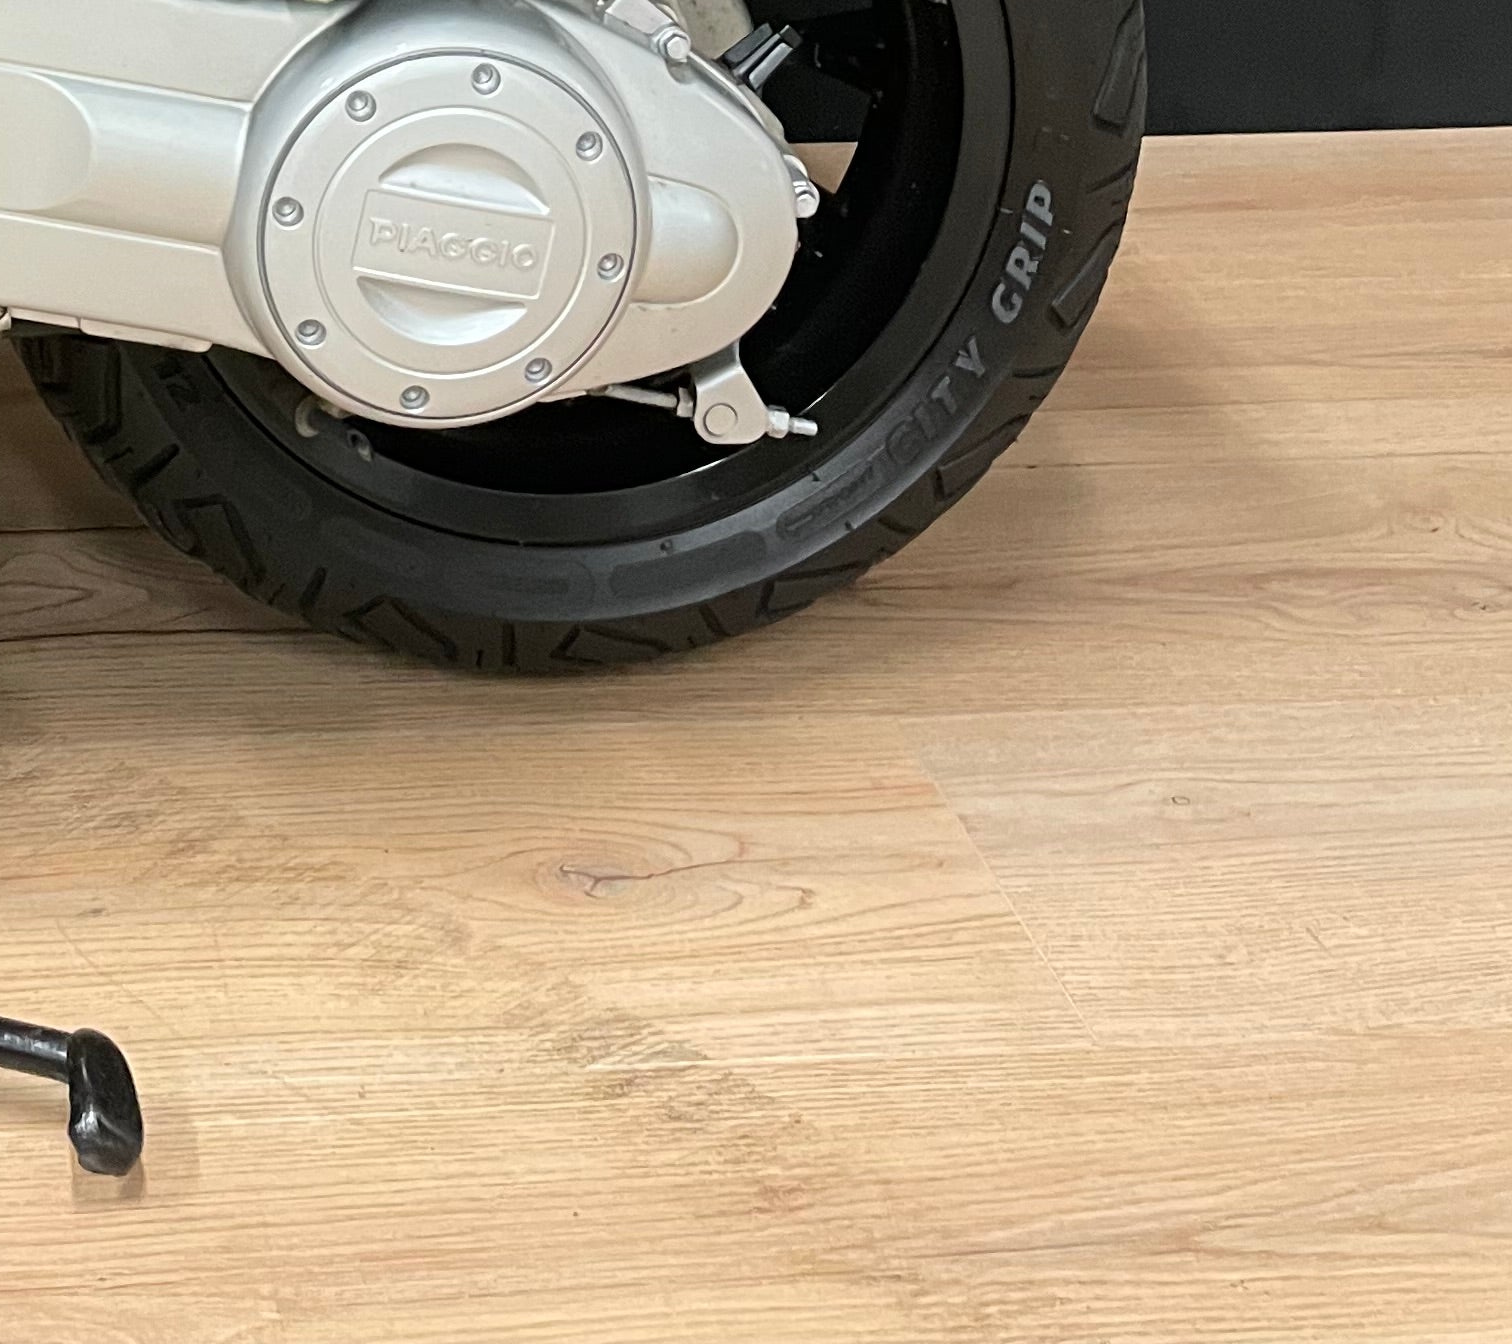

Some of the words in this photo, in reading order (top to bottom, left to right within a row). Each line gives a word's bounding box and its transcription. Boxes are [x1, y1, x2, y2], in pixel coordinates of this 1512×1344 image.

[370, 216, 536, 269] PIAGGIO
[888, 335, 986, 464] CITY
[992, 179, 1054, 324] GRIP
